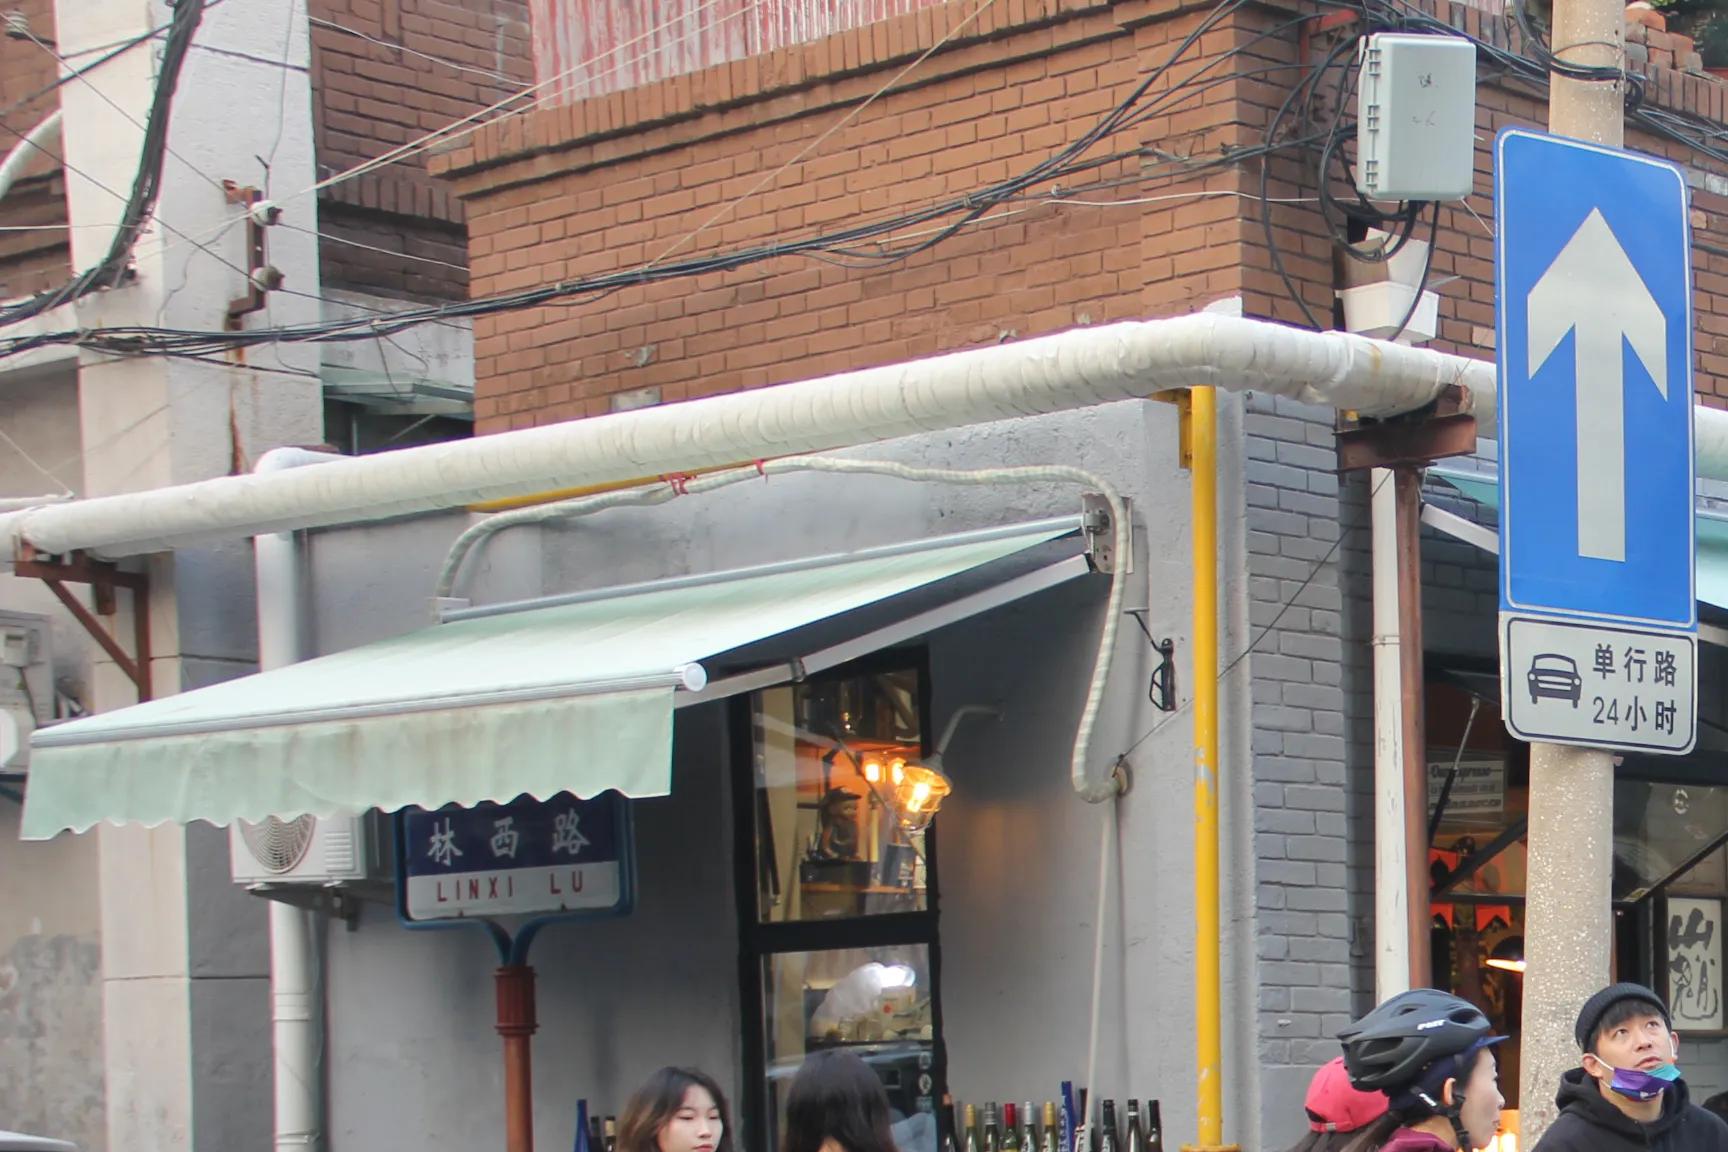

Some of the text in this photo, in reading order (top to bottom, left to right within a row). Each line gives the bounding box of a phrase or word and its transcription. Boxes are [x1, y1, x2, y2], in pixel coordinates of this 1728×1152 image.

[1593, 643, 1677, 687] 单行路
[1592, 695, 1677, 735] 24小时
[427, 808, 591, 866] 林西路
[437, 870, 584, 902] LINXI LU
